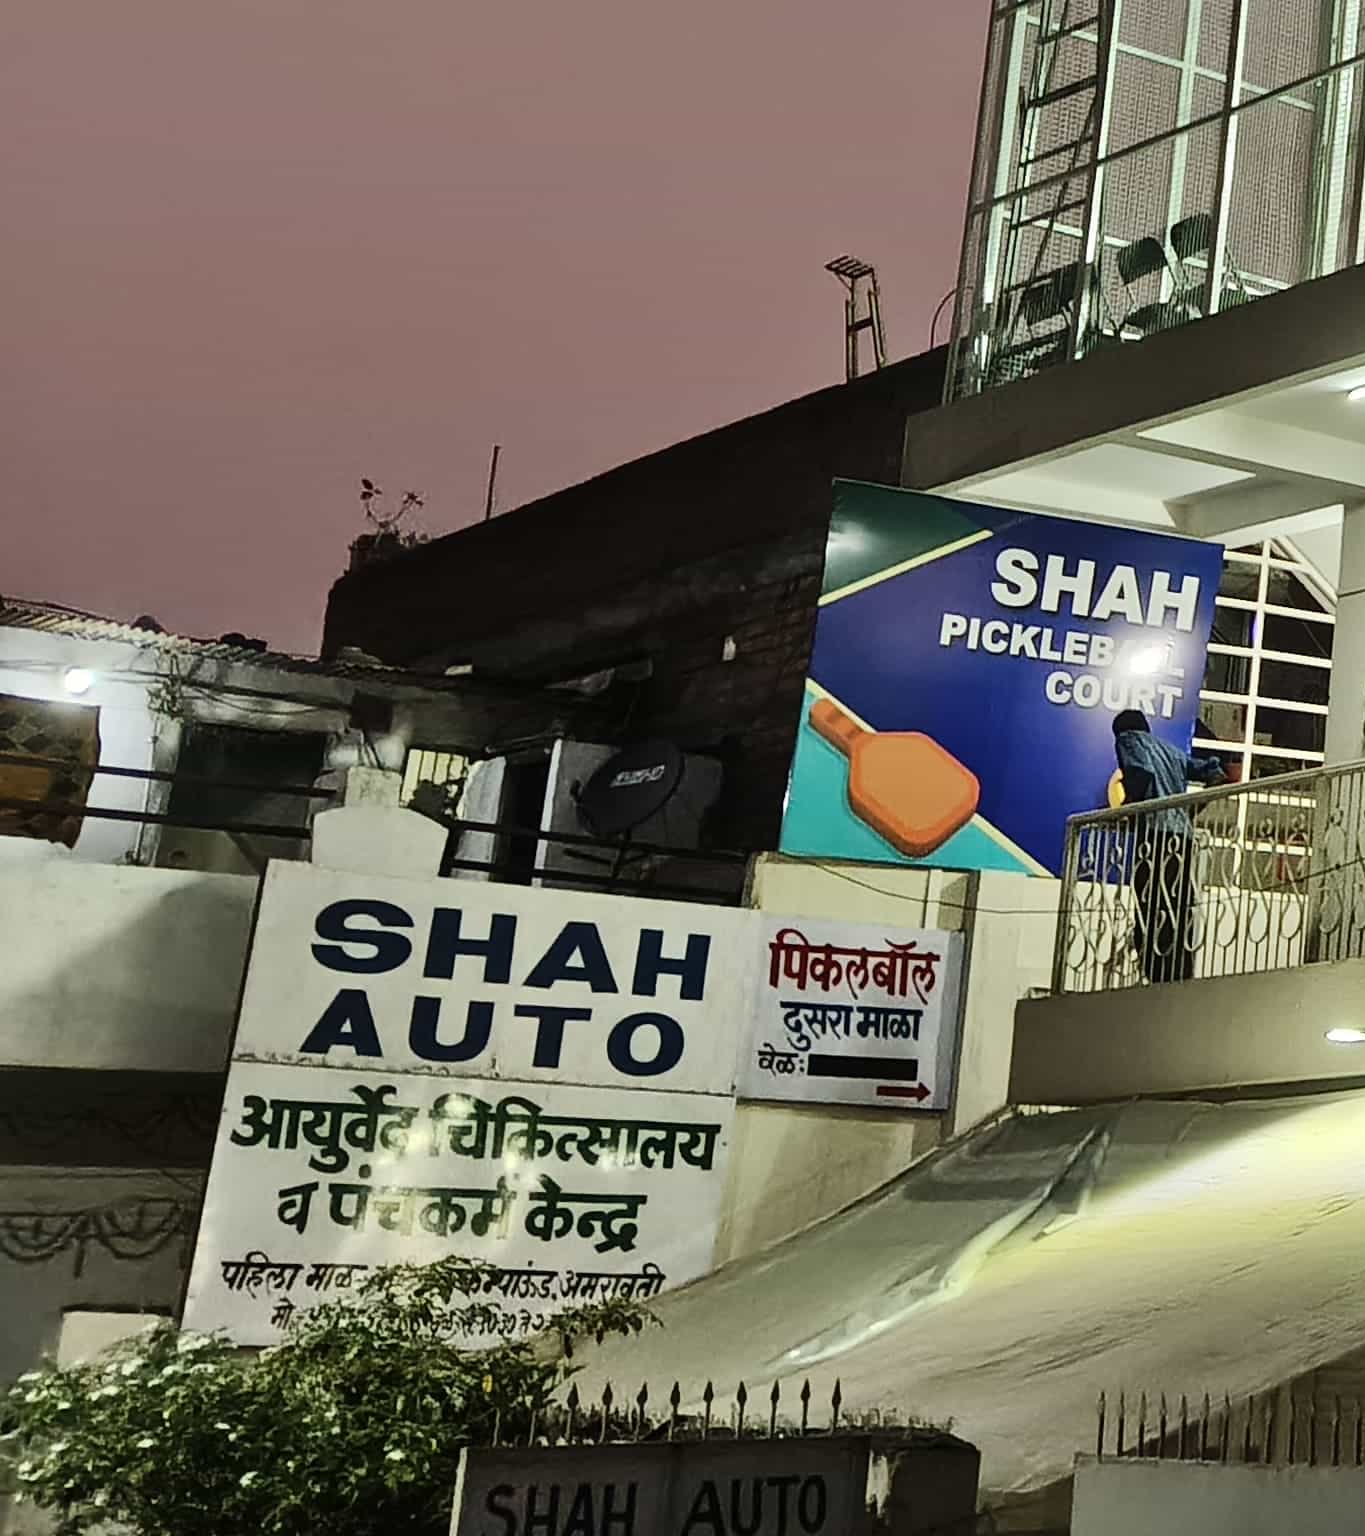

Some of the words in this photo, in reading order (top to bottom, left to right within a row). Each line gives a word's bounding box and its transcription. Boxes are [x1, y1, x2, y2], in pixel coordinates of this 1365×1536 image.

[991, 548, 1200, 633] SHAH
[939, 613, 1184, 680] PICKLEBL
[1046, 672, 1183, 719] COURT
[310, 897, 713, 1002] SHAH
[769, 928, 941, 1005] पिकलबॉल
[299, 987, 687, 1078] AUTO
[780, 1000, 853, 1052] दुसरा
[856, 1004, 924, 1041] माळा
[231, 1084, 419, 1173] आयुर्वेद
[429, 1092, 722, 1172] चिकित्सालय
[277, 1181, 319, 1234] व
[524, 1172, 647, 1253] केन्द्र
[220, 1251, 304, 1299] पहिला
[481, 1480, 639, 1536] SHAH
[680, 1473, 829, 1536] AUTO
